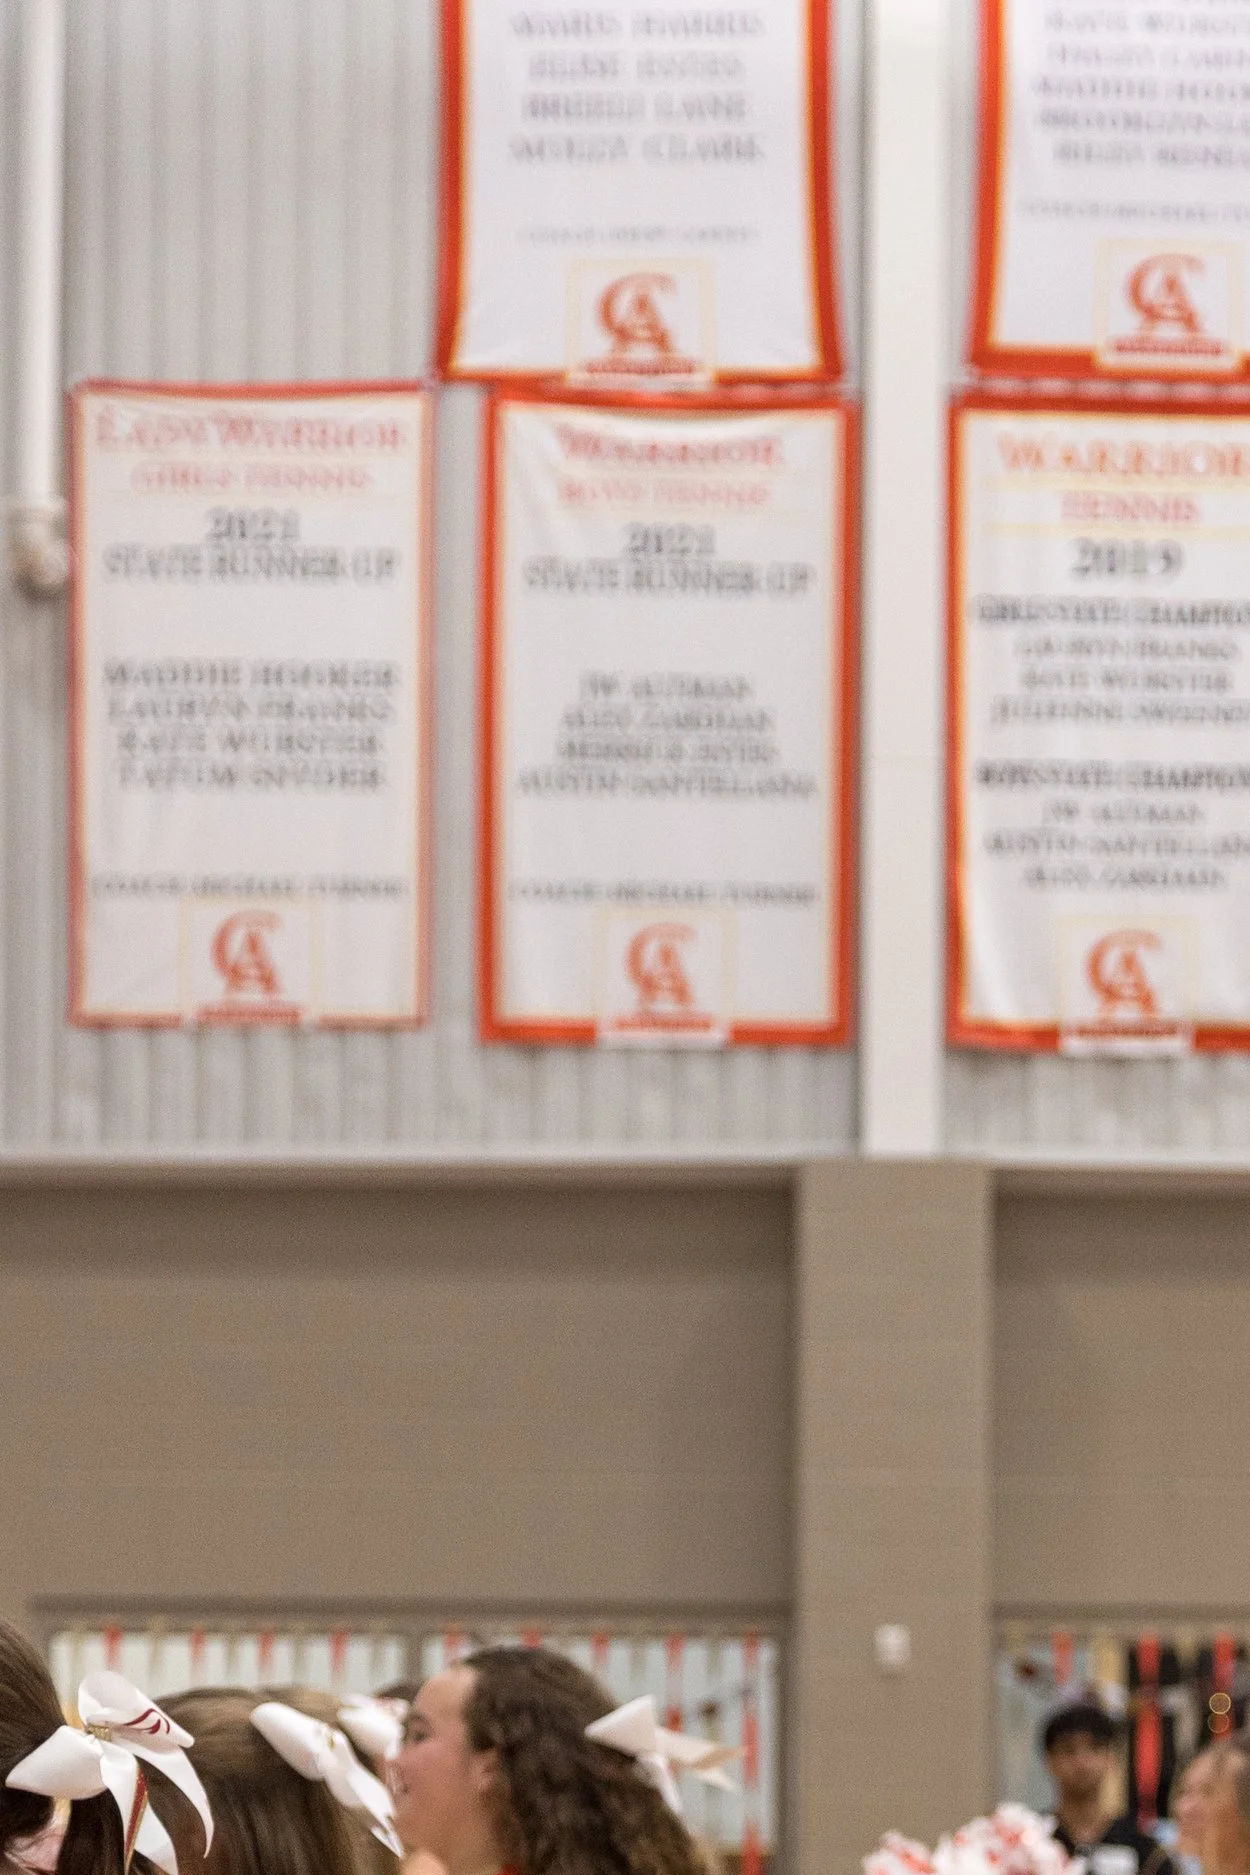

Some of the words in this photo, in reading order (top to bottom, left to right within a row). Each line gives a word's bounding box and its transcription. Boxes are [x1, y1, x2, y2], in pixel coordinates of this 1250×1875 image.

[210, 411, 410, 455] WARRIOR
[556, 422, 788, 475] WARRIOR
[205, 509, 300, 549] 2021
[622, 524, 715, 563] 2021
[103, 548, 210, 583] STATE
[521, 559, 629, 596] STATE
[1069, 540, 1182, 584] 2019
